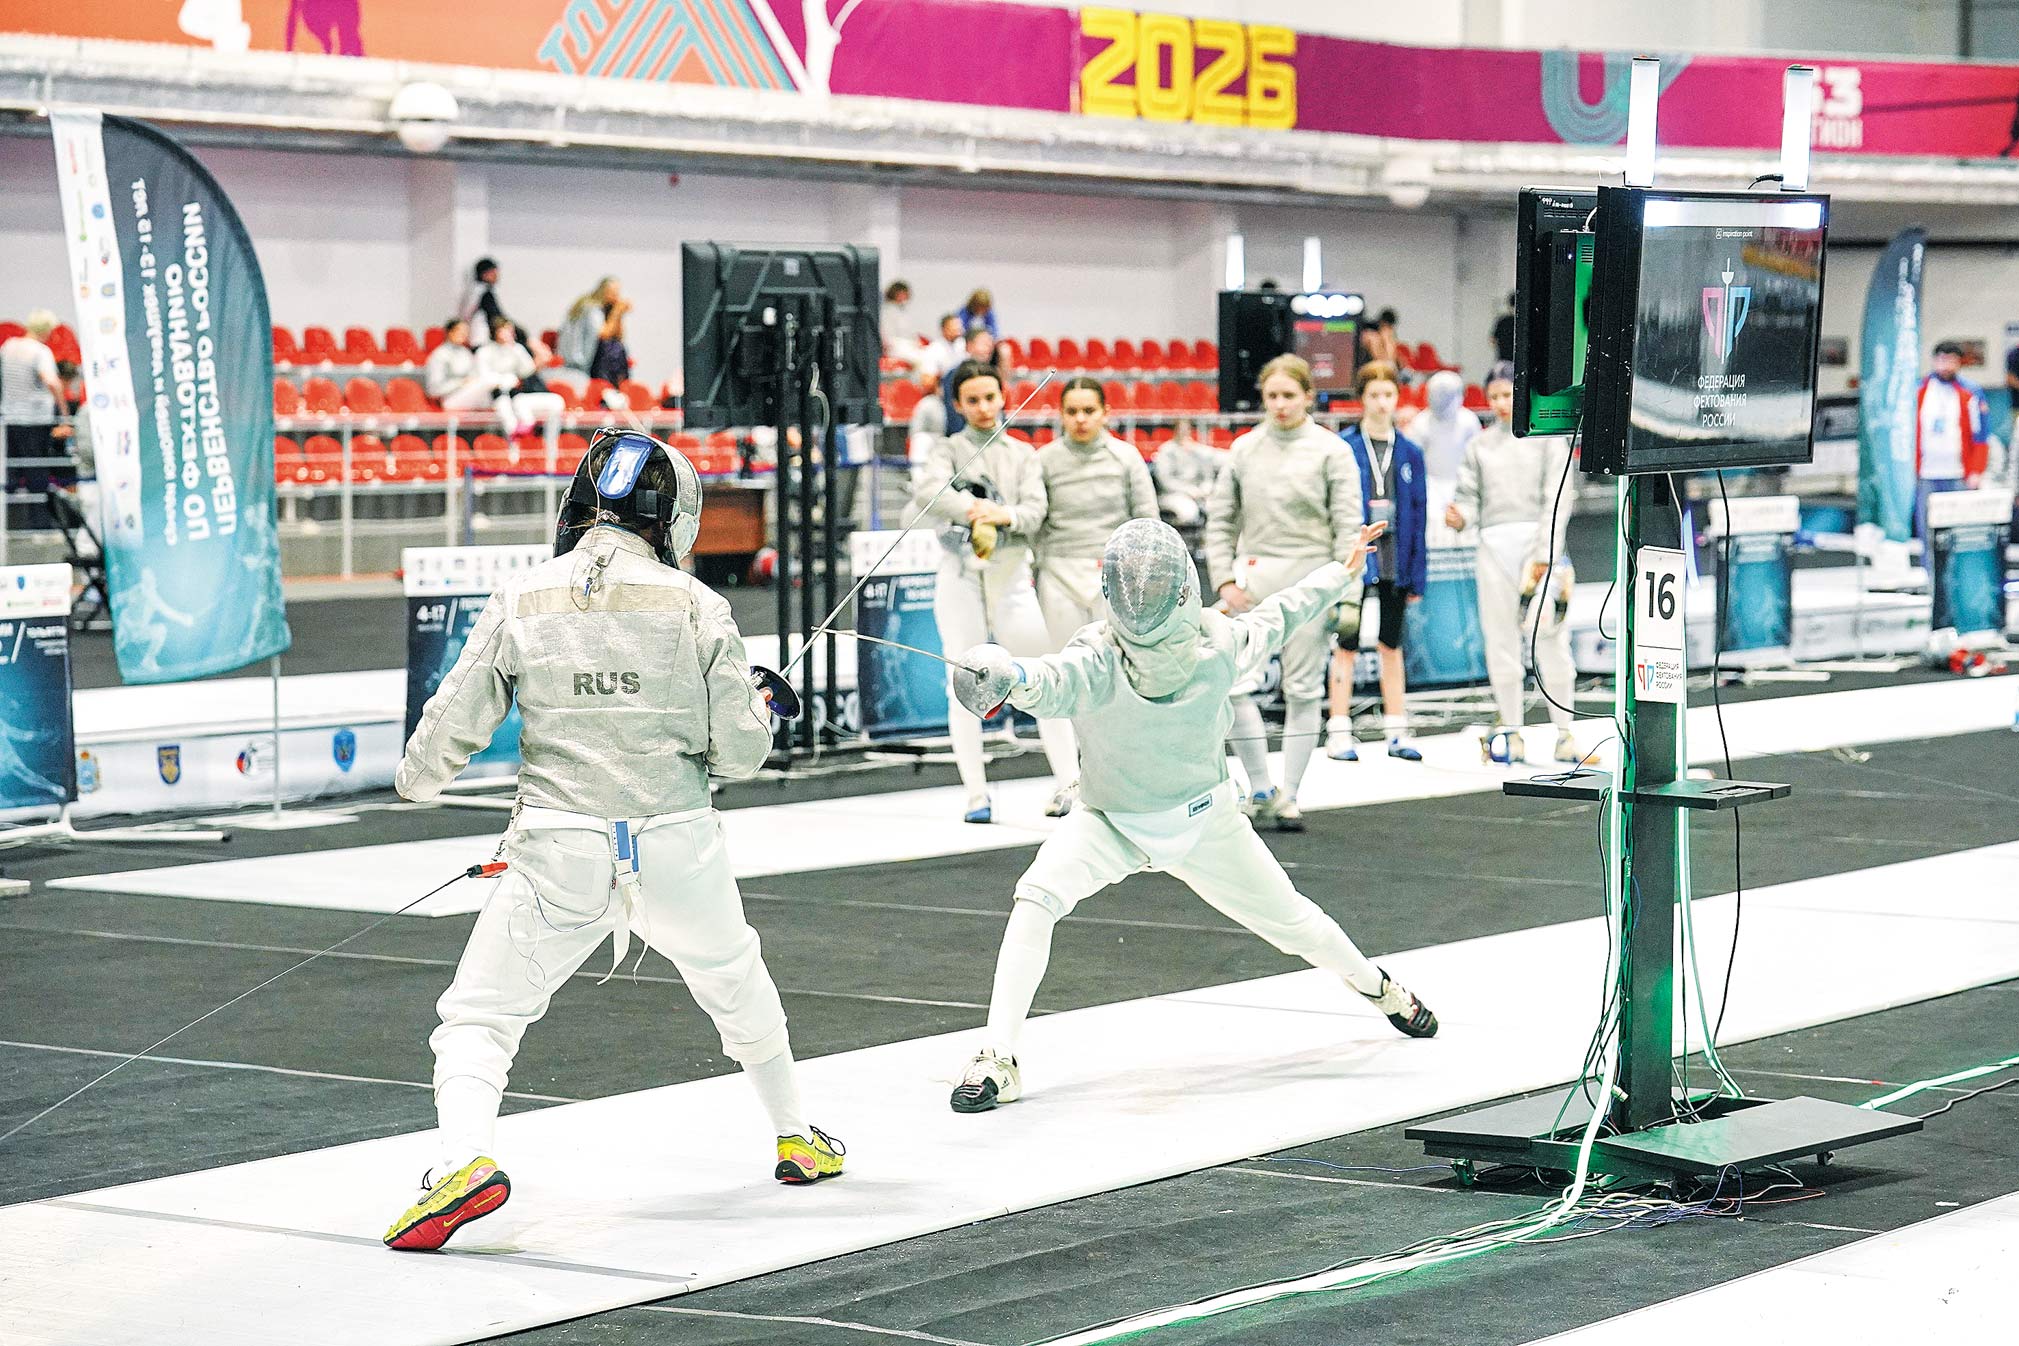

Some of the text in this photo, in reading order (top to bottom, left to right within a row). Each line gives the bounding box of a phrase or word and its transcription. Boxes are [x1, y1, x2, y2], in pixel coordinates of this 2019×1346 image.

[1081, 6, 1297, 129] 2026
[1697, 374, 1745, 390] ФЕДЕРАЦИЯ
[1693, 393, 1747, 408] ФЕХТОВАНИЯ
[1702, 413, 1736, 427] РОССИИ
[1645, 571, 1676, 620] 16
[573, 671, 641, 696] RUS
